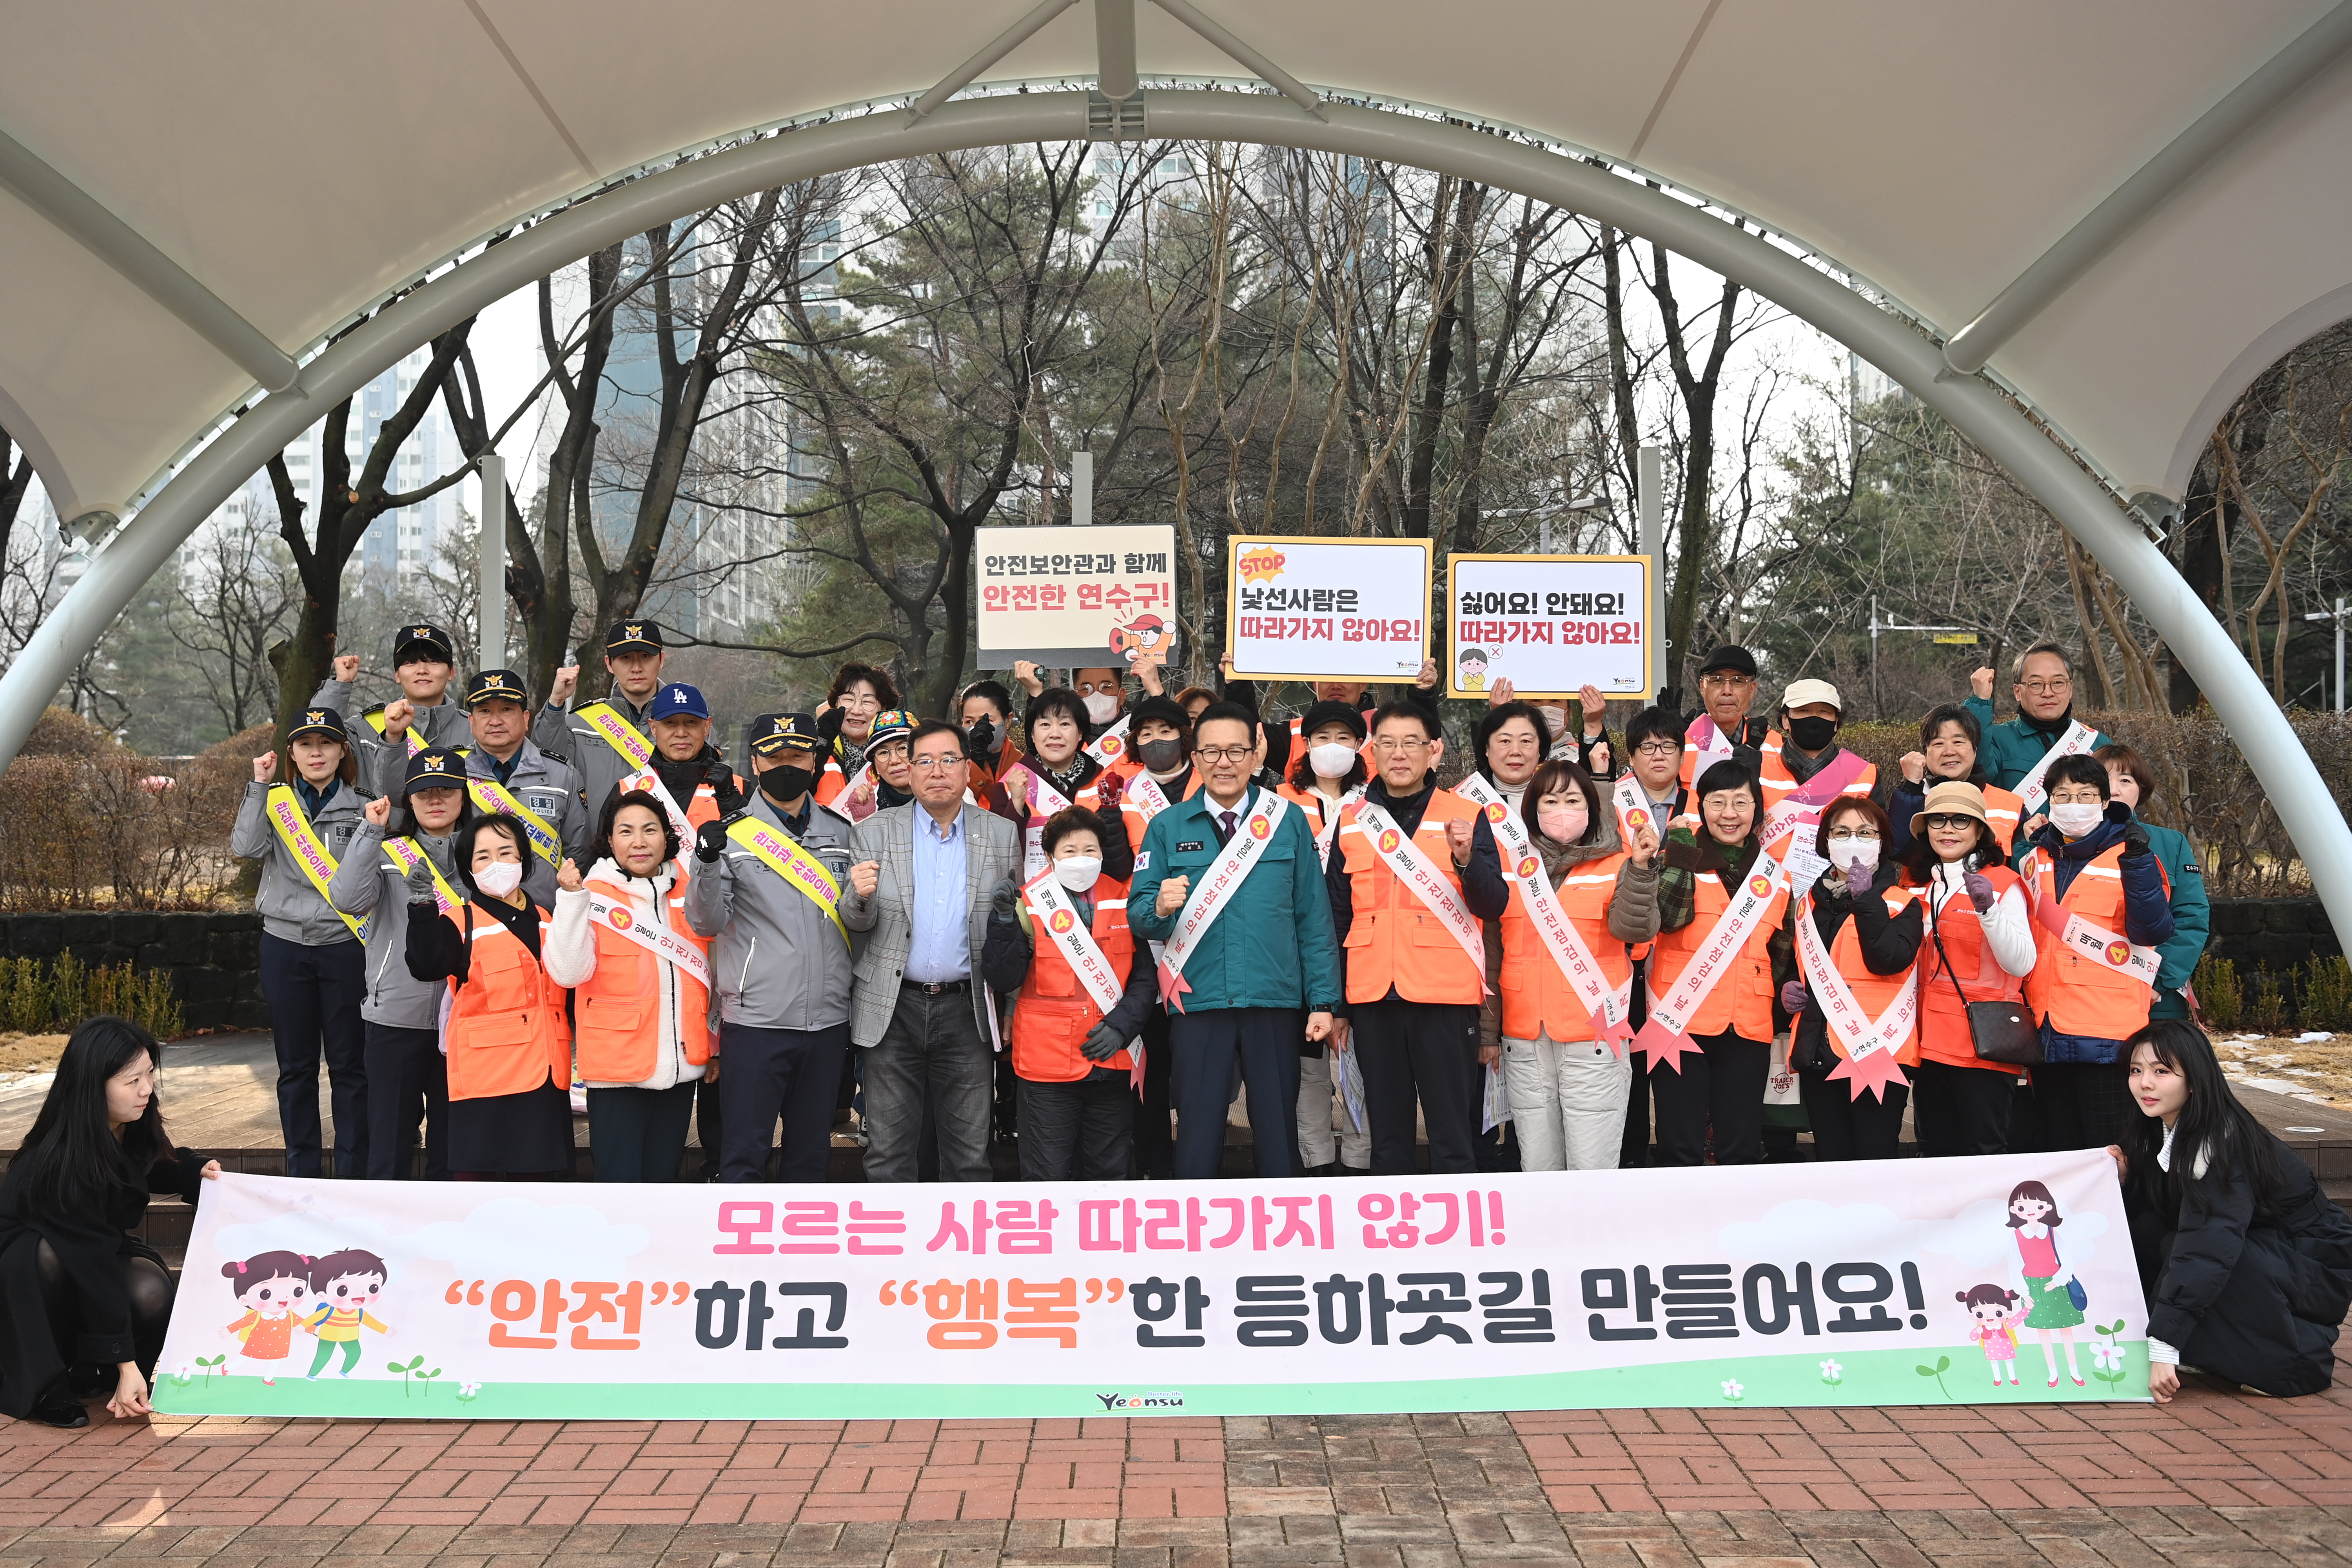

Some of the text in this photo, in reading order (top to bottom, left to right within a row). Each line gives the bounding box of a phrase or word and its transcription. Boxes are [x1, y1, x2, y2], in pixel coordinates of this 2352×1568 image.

[985, 553, 1167, 576] 안전보안관과 함께
[1239, 554, 1285, 576] STOP
[983, 582, 1169, 611] 안전한 연수구!
[1241, 588, 1359, 612] 낯선사람은
[1460, 592, 1624, 615] 싫어요! 안돼요!
[1240, 617, 1420, 642] 따라가지 않아요!
[1460, 621, 1640, 645] 따라가지 않아요!
[673, 688, 687, 704] LA
[596, 713, 650, 766] 관심과 사랑으
[1102, 740, 1119, 752] 4
[532, 798, 552, 808] 경찰
[1141, 780, 1165, 808] 연수구
[1265, 797, 1278, 818] 매월
[1470, 787, 1521, 841] 매월 4 일은
[1621, 789, 1644, 825] 매월 4
[1252, 820, 1268, 837] 4
[274, 800, 334, 881] 관심과 사랑으로
[1236, 837, 1255, 860] 일은
[1517, 844, 1528, 858] 매월
[1797, 835, 1815, 846] 연수구
[752, 831, 836, 904] 관심과 사랑으로
[1521, 858, 1535, 875] 4
[1367, 813, 1482, 955] 매월 4 일은 안전점검의 날
[1528, 877, 1541, 897] 일은
[1184, 860, 1240, 935] 안전점검의
[612, 911, 630, 928] 4
[635, 923, 657, 941] 일은
[660, 936, 711, 980] 안전점검
[1174, 937, 1186, 955] 날
[1536, 897, 1589, 975] 안전점검의
[1673, 859, 1776, 1011] 매월 4 일은 안전점검의 날
[2065, 926, 2076, 944] Yeonsu
[1041, 889, 1120, 1007] 매월 4 일은 안전점
[2079, 932, 2105, 951] 매월
[2109, 945, 2128, 964] 4
[2131, 954, 2146, 969] 일은
[1167, 956, 1180, 973] 연수구
[1586, 979, 1601, 996] 날
[1800, 918, 1809, 940] 일은
[1805, 939, 1848, 1014] 안전점검의
[1845, 1019, 1862, 1036] 날
[1606, 1003, 1616, 1023] 연수구
[1662, 1014, 1682, 1030] 연수구
[1882, 1023, 1898, 1040] 날
[1858, 1036, 1879, 1053] 연수구
[712, 1190, 1506, 1255] 모르는 사람 따라가지 않기!
[445, 1260, 1928, 1351] “안전”하고 “행복”한 등하굣길 만들어요!
[1096, 1393, 1183, 1411] Yeonsu
